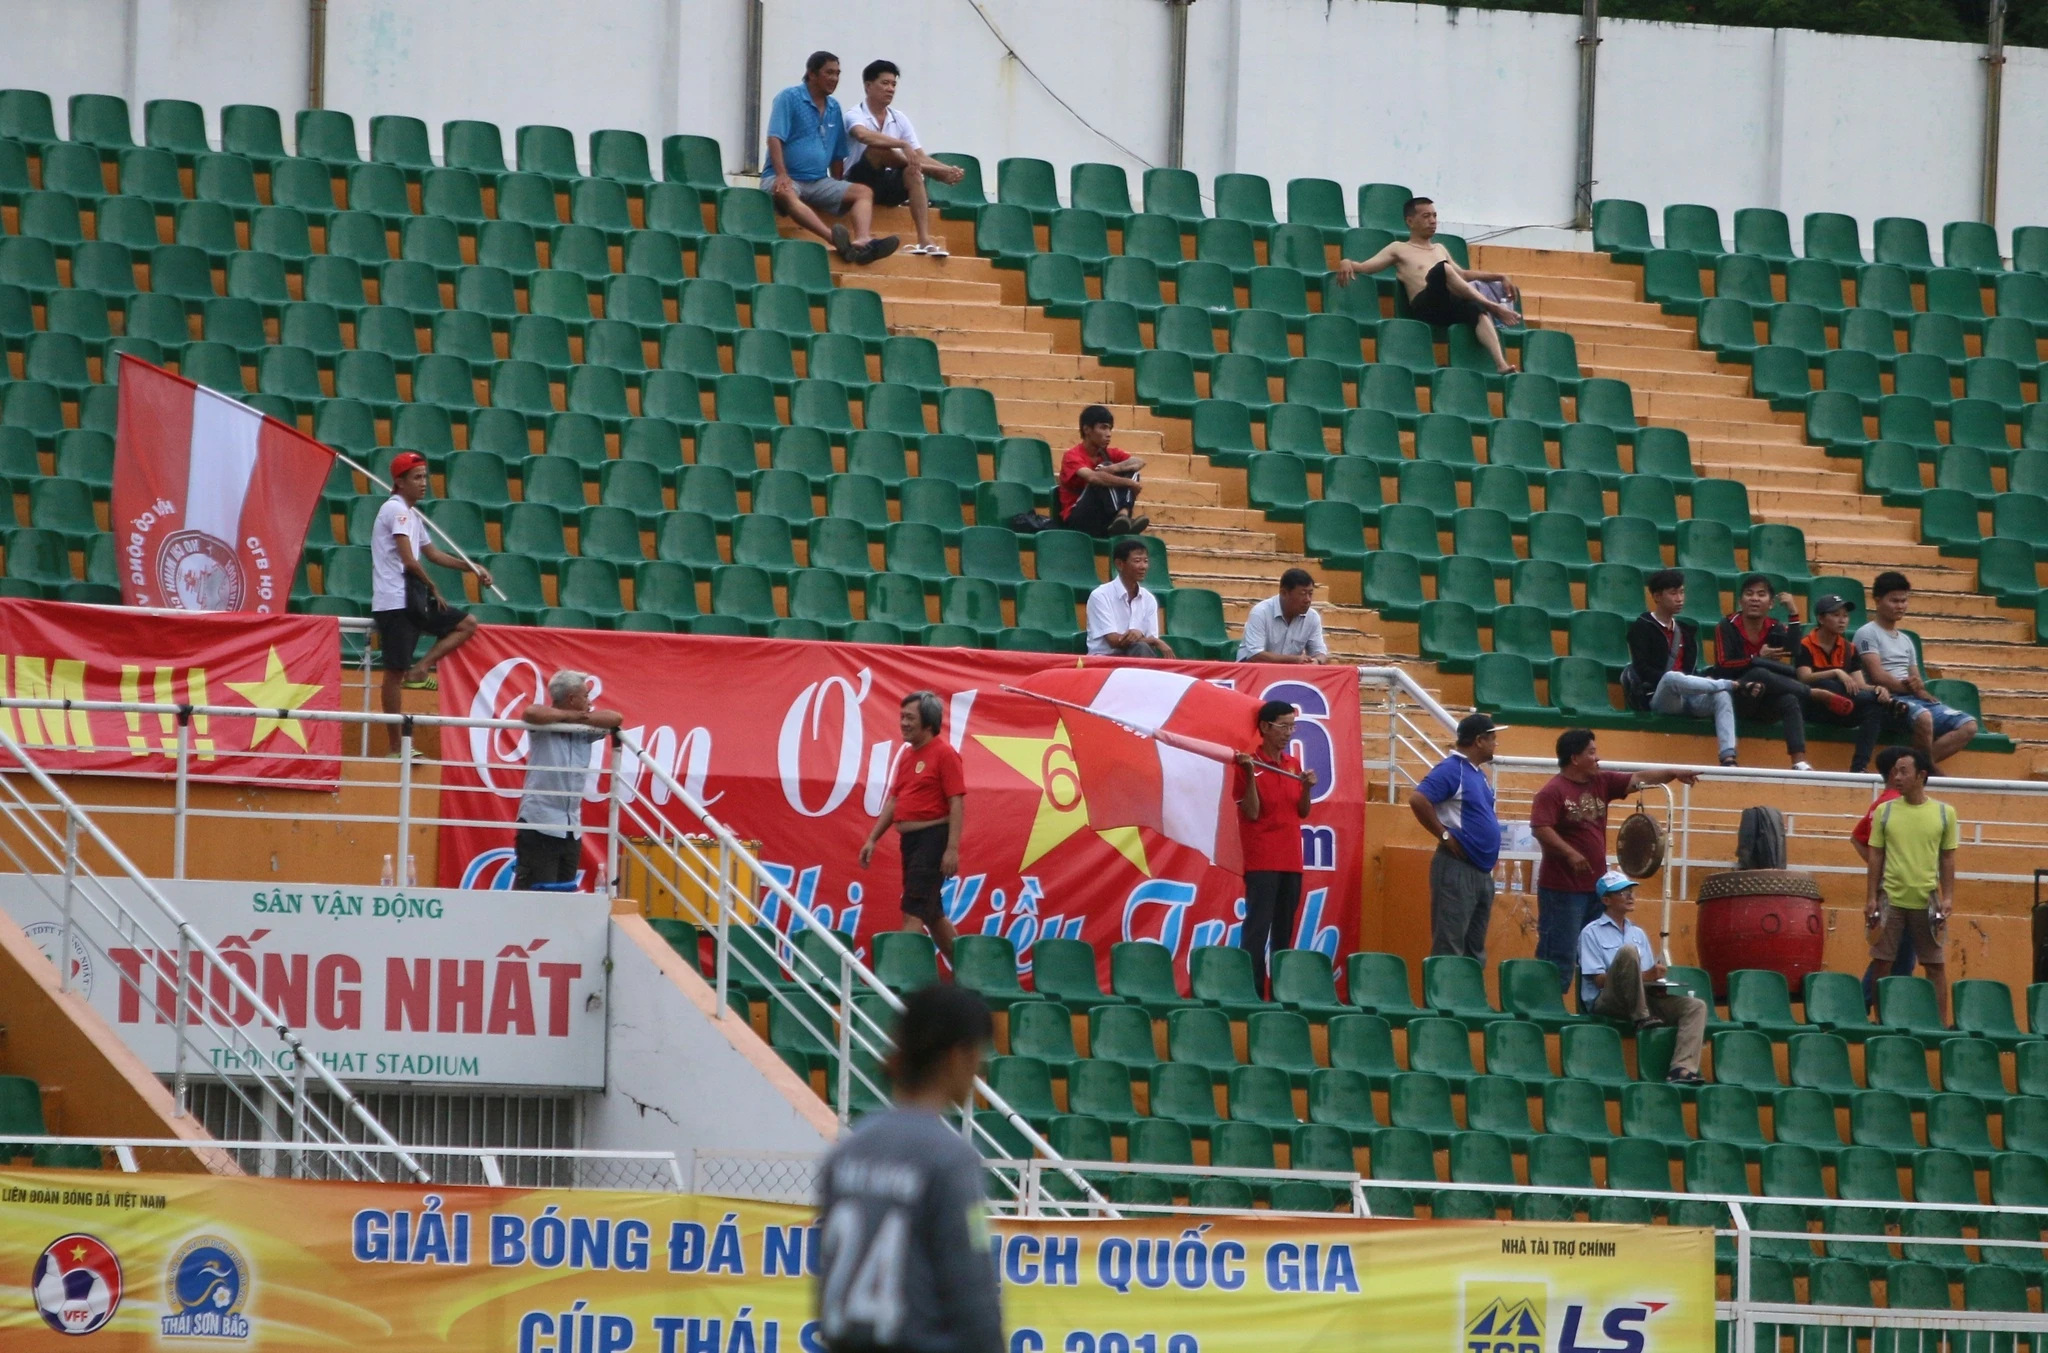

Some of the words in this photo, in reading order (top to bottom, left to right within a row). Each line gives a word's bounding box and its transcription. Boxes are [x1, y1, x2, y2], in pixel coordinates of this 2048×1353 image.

[1042, 742, 1083, 812] 6
[253, 888, 302, 914] SÂN
[311, 890, 363, 921] VẬN
[372, 893, 444, 923] ĐỘNG
[108, 929, 362, 1030] THỐNG
[385, 938, 582, 1037] NHẤT
[376, 1053, 479, 1076] STADIUM
[2, 1186, 27, 1203] LIÊN
[29, 1189, 59, 1205] ĐOÀN
[63, 1189, 93, 1206] BÓNG
[96, 1191, 110, 1207] ĐÁ
[114, 1192, 137, 1211] VIỆT
[140, 1194, 166, 1209] NAM
[352, 1194, 471, 1266] GIẢI
[489, 1205, 650, 1272] BÓNG
[667, 1213, 745, 1275] ĐÁ
[1097, 1223, 1247, 1294] QUỐC
[1265, 1242, 1361, 1293] GIA
[1501, 1236, 1526, 1254] NHÀ
[1531, 1239, 1549, 1255] TÀI
[1552, 1240, 1576, 1259] TRỢ
[1579, 1239, 1616, 1257] CHÍNH
[63, 1310, 88, 1322] VFF
[163, 1312, 190, 1334] THÁI
[193, 1311, 219, 1334] SƠN
[222, 1313, 248, 1336] BẮC
